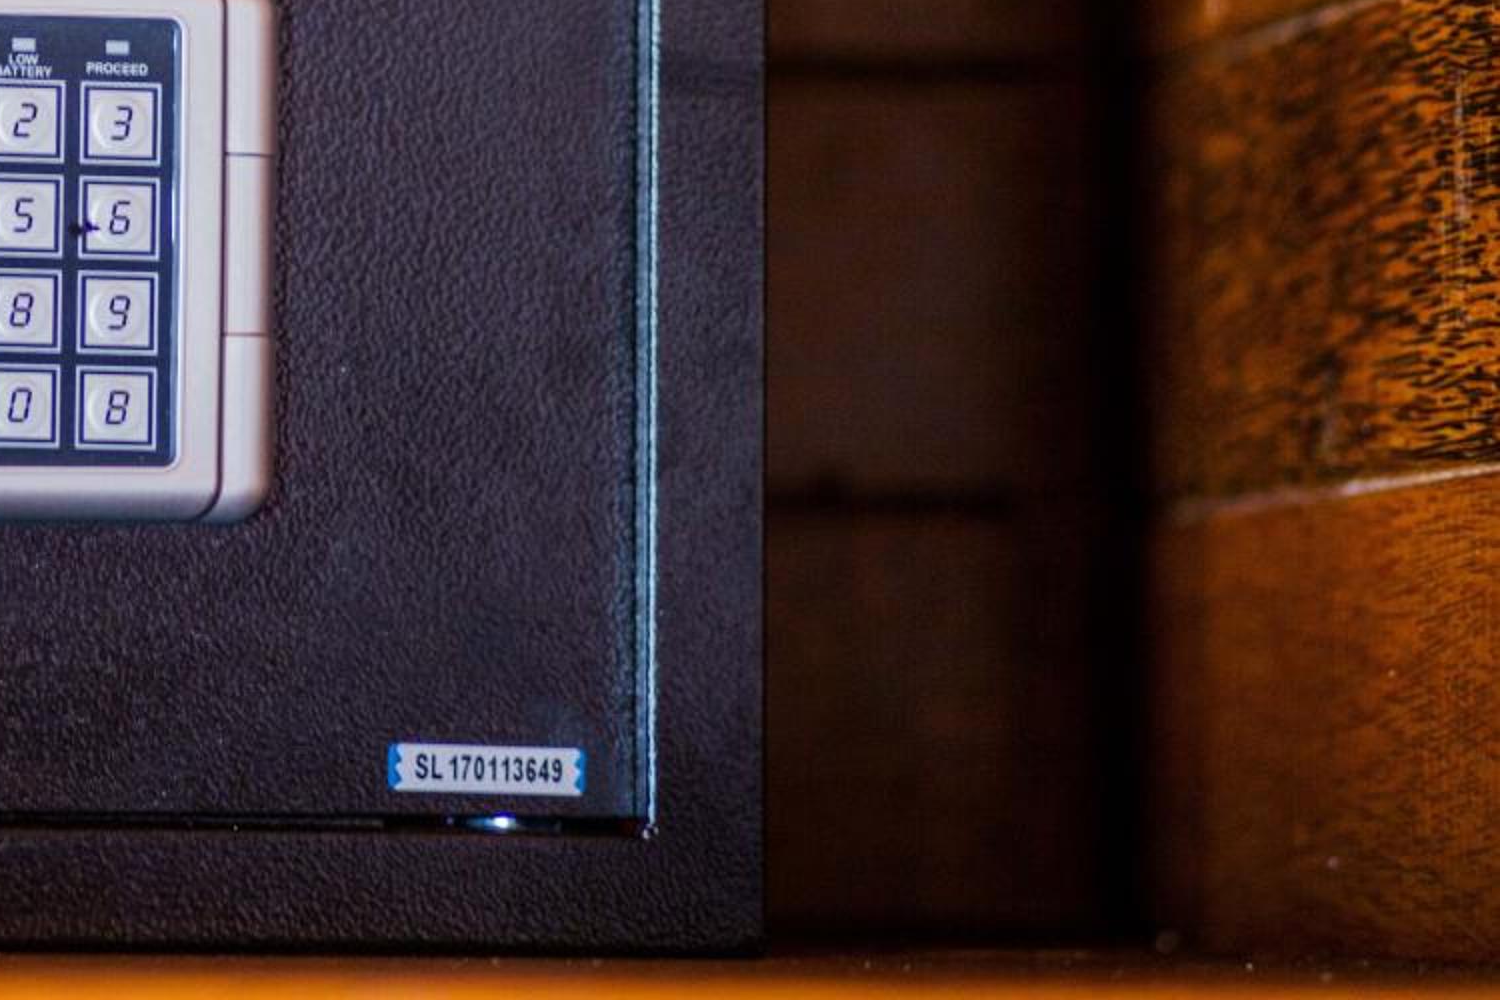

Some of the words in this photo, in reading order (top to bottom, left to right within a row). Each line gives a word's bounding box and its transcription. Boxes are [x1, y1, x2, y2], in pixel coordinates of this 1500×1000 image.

[8, 53, 40, 66] LOW
[85, 61, 149, 77] PROCEED
[13, 102, 38, 138] 2
[111, 105, 133, 141] 3
[14, 197, 34, 233] 5
[108, 200, 131, 235] 6
[9, 292, 34, 328] 8
[108, 294, 131, 330] 9
